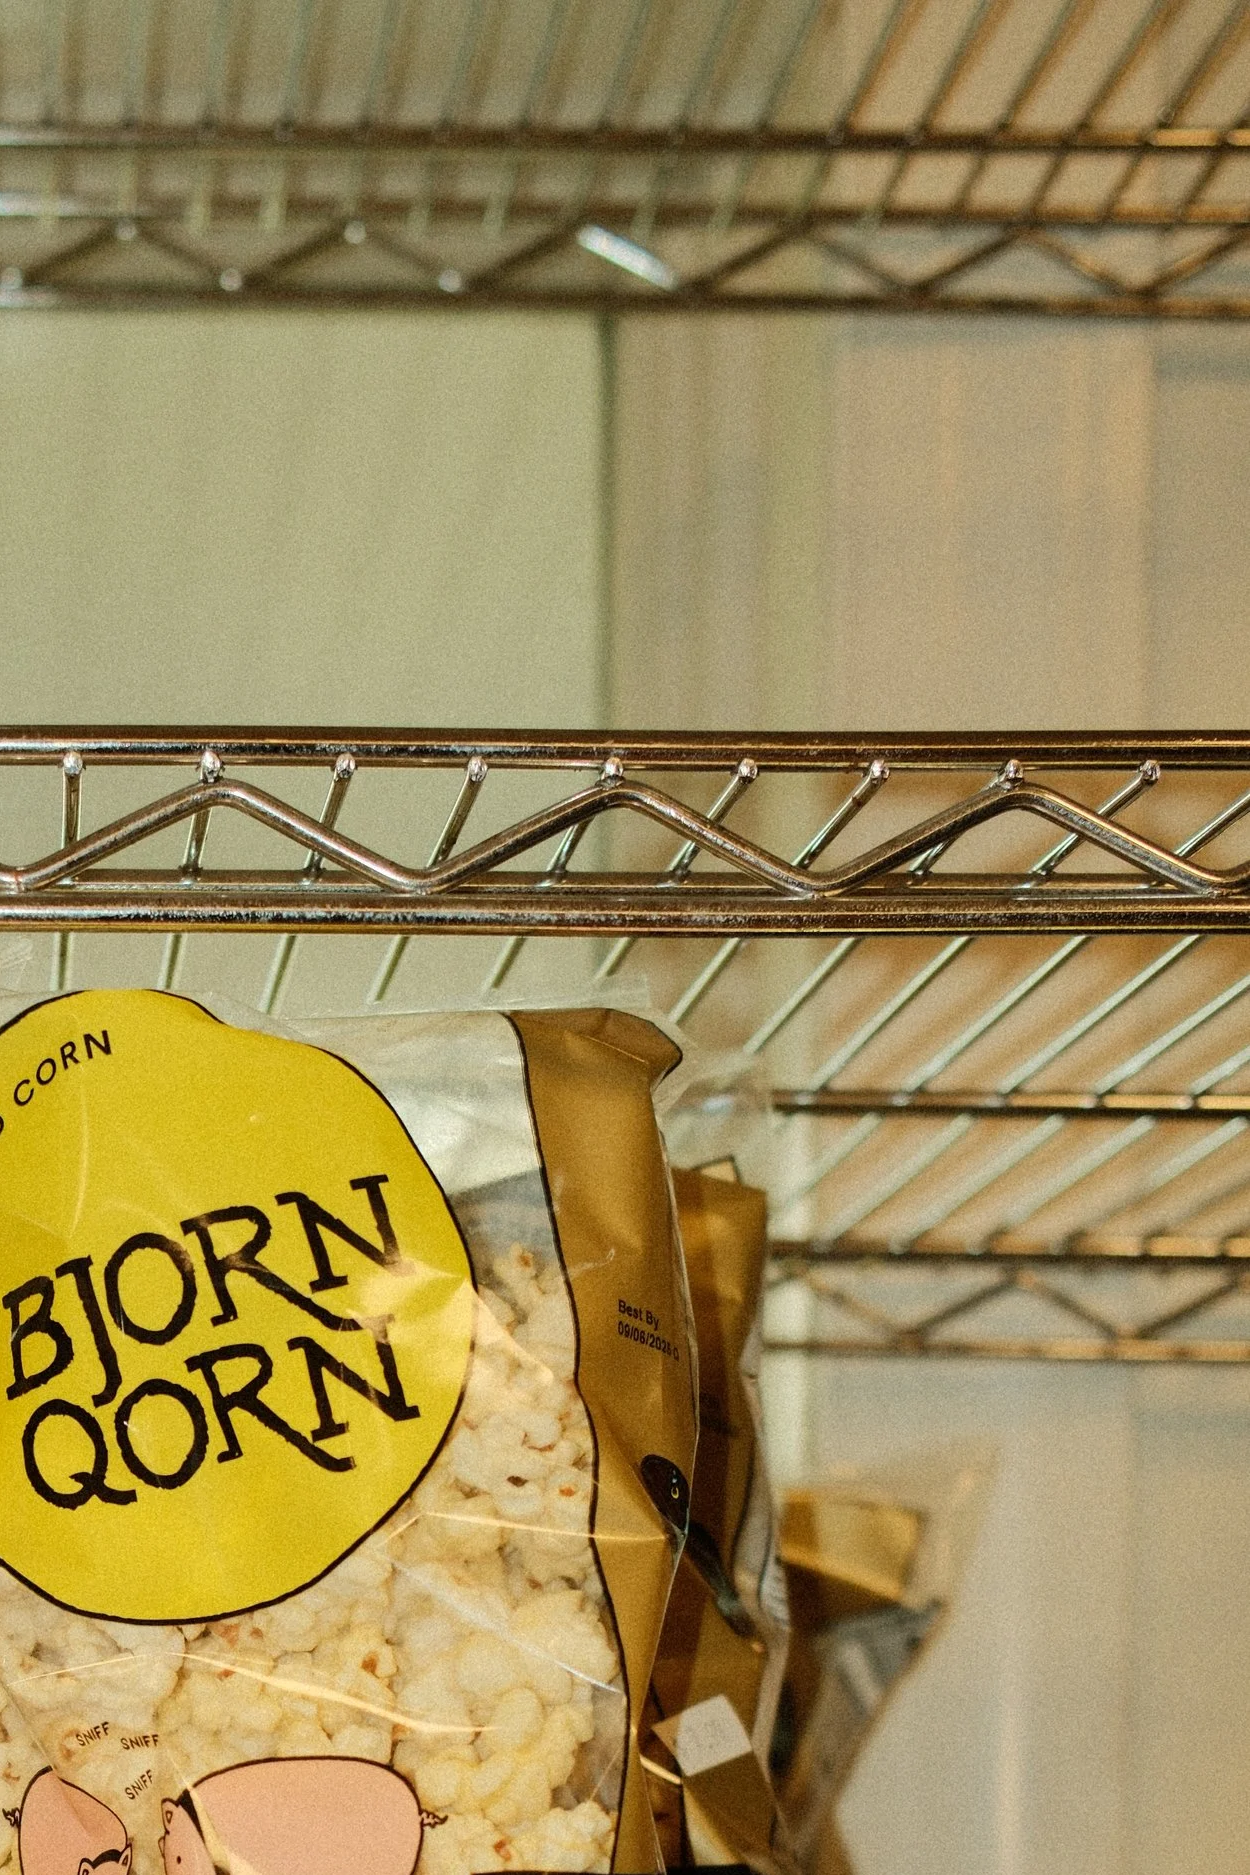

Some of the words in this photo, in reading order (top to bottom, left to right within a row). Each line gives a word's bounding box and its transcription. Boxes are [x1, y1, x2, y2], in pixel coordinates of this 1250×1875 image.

[12, 1029, 114, 1107] CORN
[2, 1173, 410, 1406] BJORN
[617, 1299, 643, 1322] Best
[645, 1310, 659, 1331] By
[20, 1313, 422, 1510] QORN
[75, 1720, 110, 1747] SNIFF
[119, 1733, 159, 1750] SNIFF
[124, 1769, 154, 1801] SNIFF
